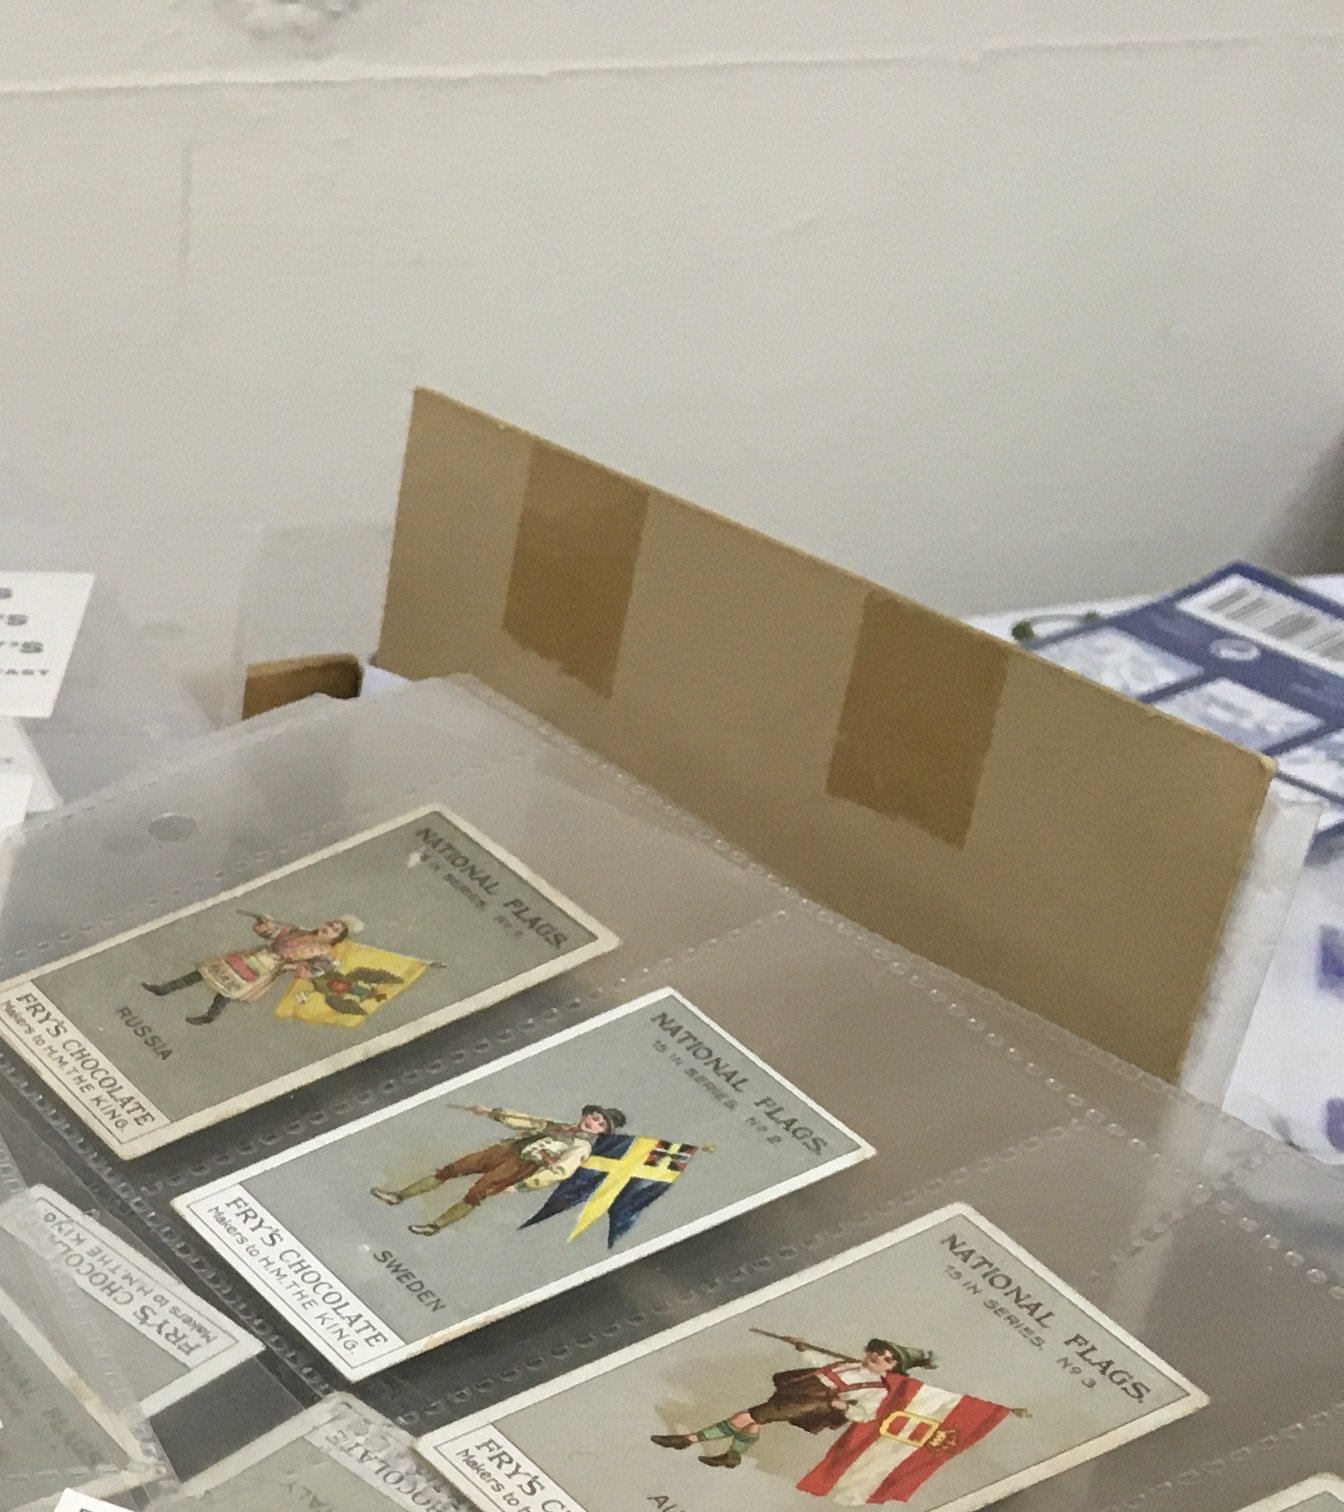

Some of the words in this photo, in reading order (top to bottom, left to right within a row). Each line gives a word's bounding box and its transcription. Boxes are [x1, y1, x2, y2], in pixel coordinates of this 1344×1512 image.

[415, 827, 500, 896] NATIONAL
[3, 1000, 35, 1034] Makers
[32, 1034, 45, 1046] to
[116, 1006, 173, 1060] RUSSIA
[650, 1012, 749, 1093] NATIONAL
[16, 992, 68, 1038] FRY'S
[62, 1039, 155, 1126] CHOCOLATE
[767, 1135, 783, 1145] 2
[208, 1206, 248, 1244] Makers
[246, 1243, 260, 1257] to
[315, 1312, 356, 1355] KING.
[226, 1196, 284, 1247] FRY'S
[280, 1248, 388, 1347] CHOCOLATE
[373, 1250, 447, 1313] SWEDEN
[941, 1233, 1056, 1329] NATIONAL
[456, 1448, 504, 1492] Makers
[502, 1491, 520, 1508] to
[475, 1438, 545, 1496] FRY'S
